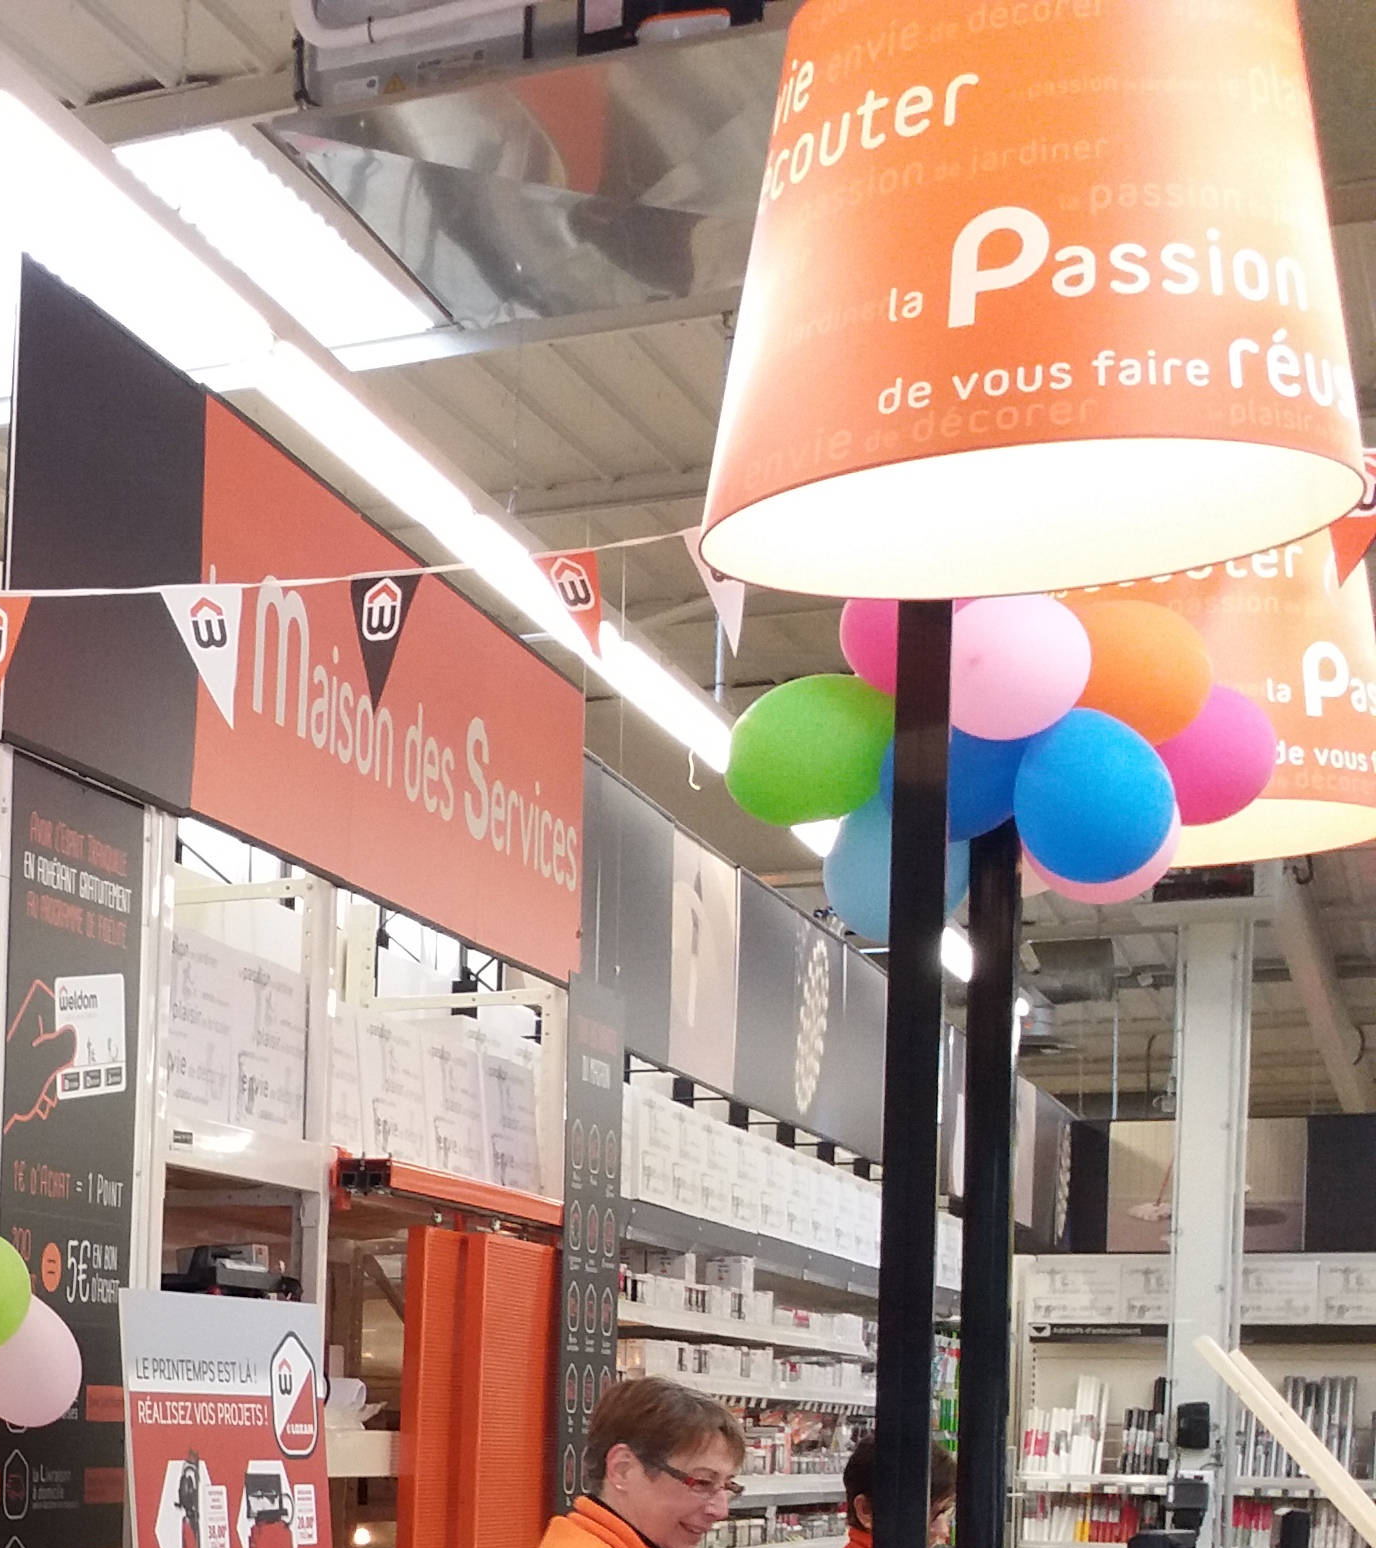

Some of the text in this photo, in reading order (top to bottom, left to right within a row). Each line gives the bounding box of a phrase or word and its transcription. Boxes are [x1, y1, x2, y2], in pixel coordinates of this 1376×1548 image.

[889, 205, 1310, 330] la Passion
[877, 378, 933, 416] de
[952, 361, 1074, 400] vous
[1091, 349, 1211, 389] faire
[1266, 677, 1293, 704] la
[1312, 745, 1367, 773] vous
[404, 703, 455, 823] des
[464, 716, 579, 894] Services
[135, 1357, 149, 1380] LE
[151, 1358, 215, 1383] PRINTEMPS
[217, 1361, 237, 1383] EST
[137, 1396, 192, 1425] RÉALISEZ
[194, 1402, 215, 1425] VOS
[217, 1402, 263, 1426] PROJETS
